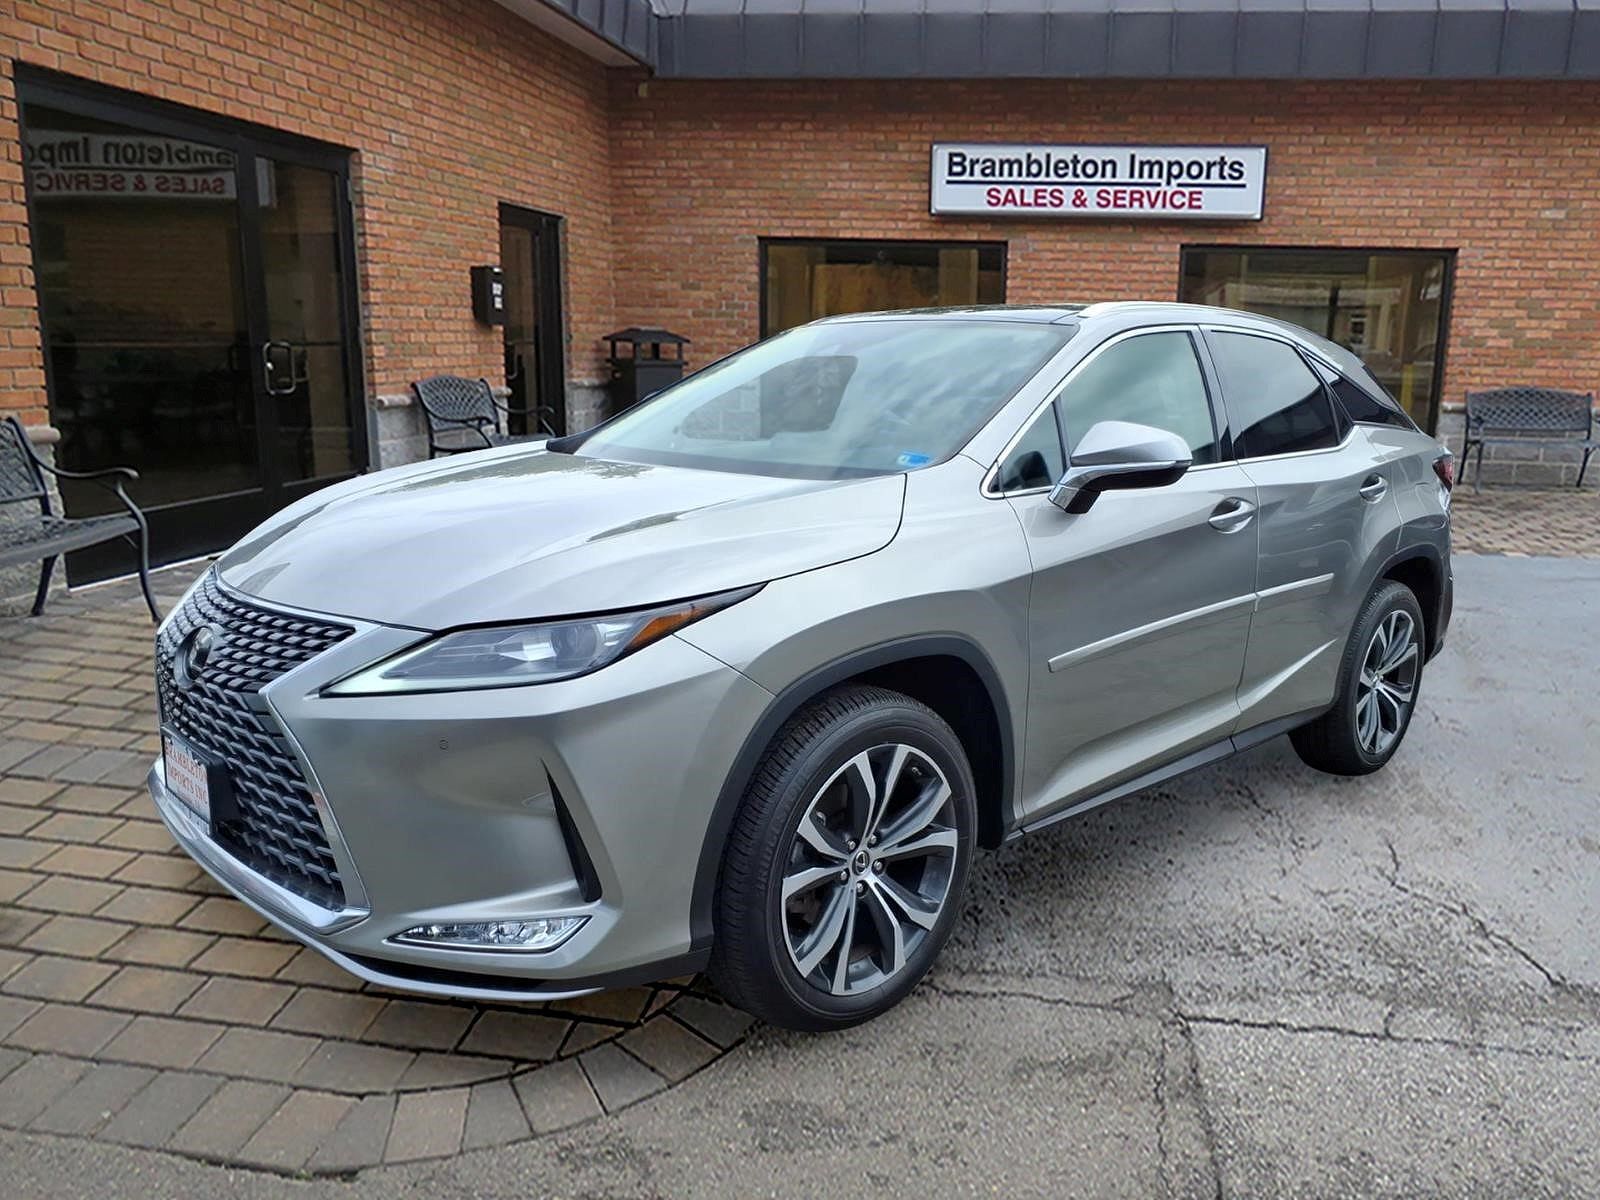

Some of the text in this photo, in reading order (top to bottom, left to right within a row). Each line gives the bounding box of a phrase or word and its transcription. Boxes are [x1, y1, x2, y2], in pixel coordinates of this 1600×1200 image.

[948, 152, 1245, 187] Brambleton Imports
[986, 187, 1202, 210] SALES & SERVICE
